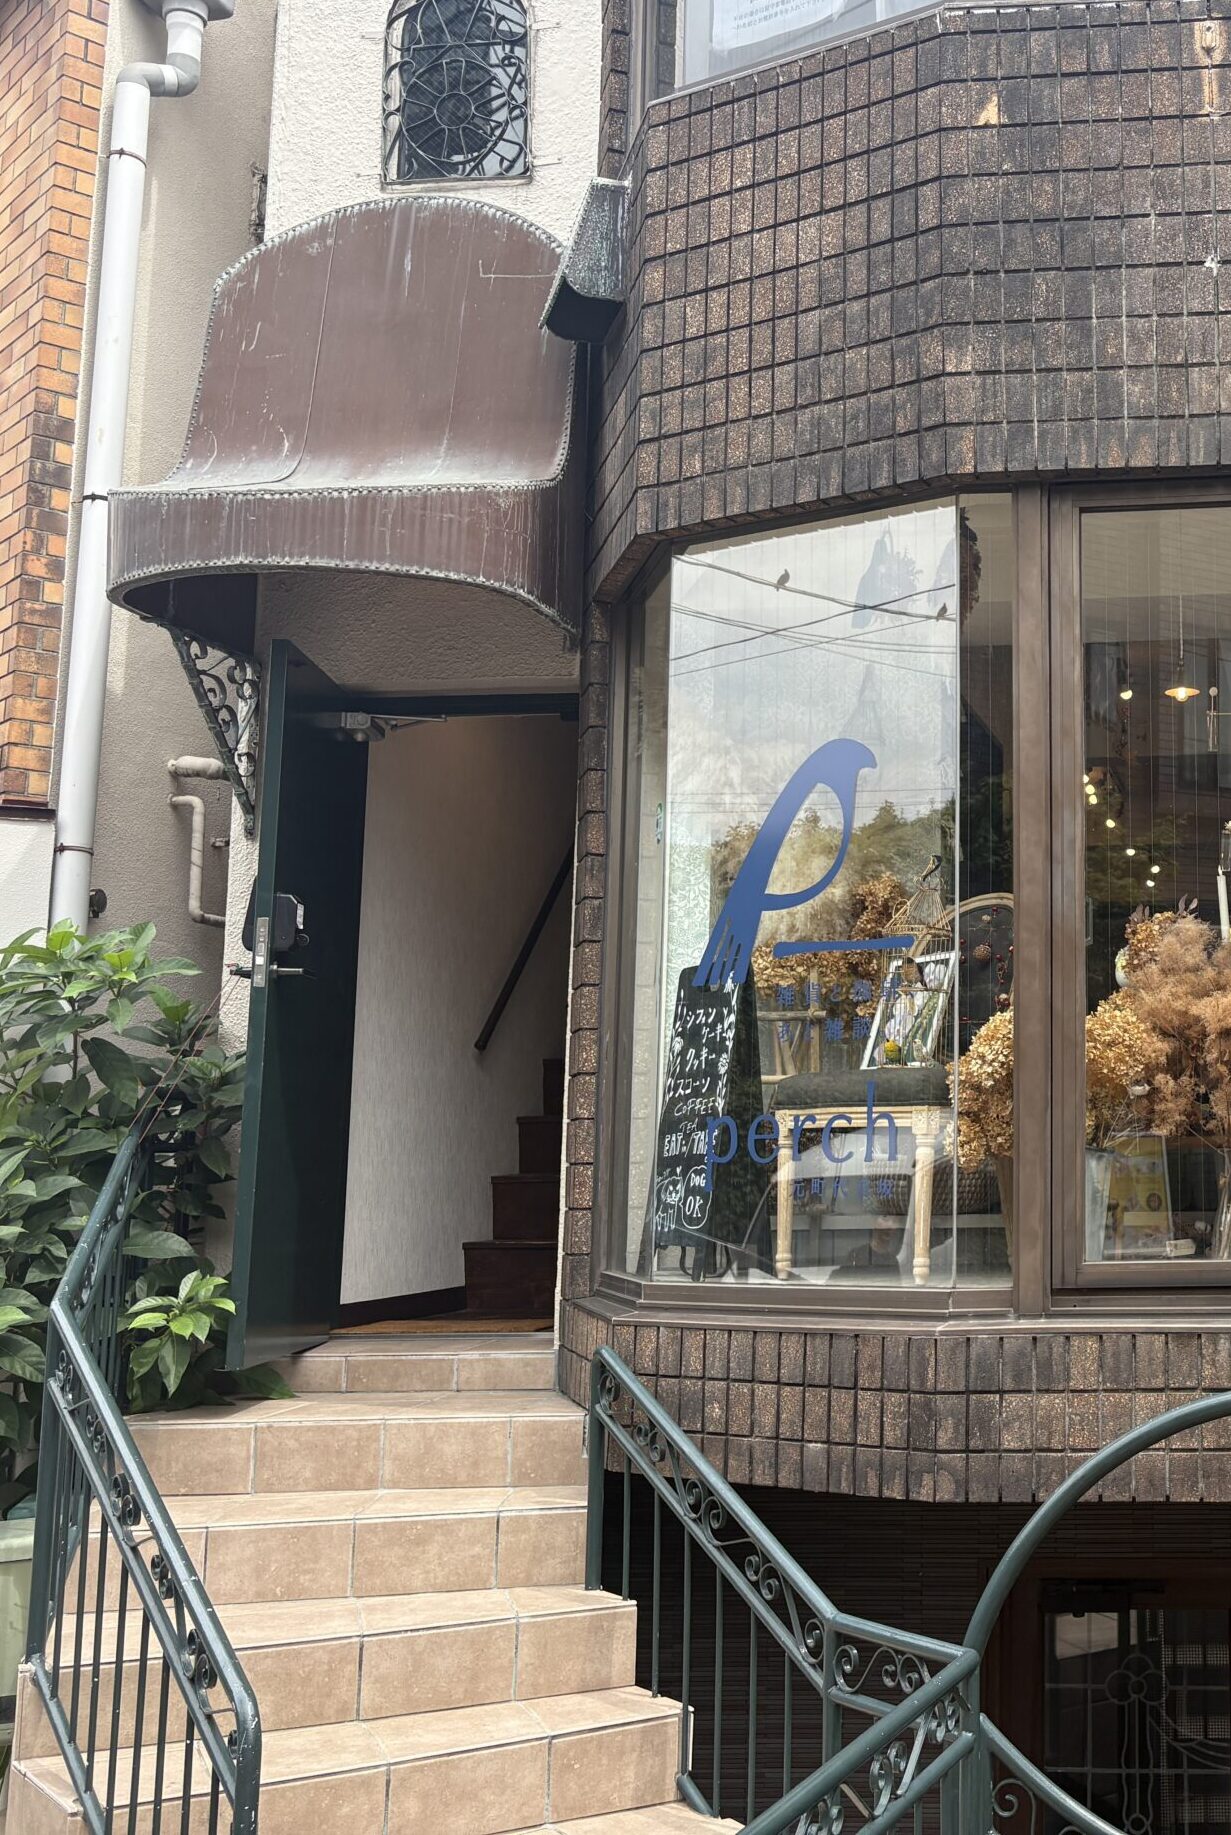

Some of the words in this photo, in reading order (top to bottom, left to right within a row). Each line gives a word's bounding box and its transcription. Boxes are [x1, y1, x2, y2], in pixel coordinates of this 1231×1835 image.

[685, 1046, 716, 1072] クッキー
[675, 1076, 711, 1098] スコーン
[679, 1118, 699, 1134] TEA
[705, 1080, 898, 1192] perch
[791, 1177, 896, 1201] 元町代坂
[685, 1195, 704, 1218] OK
